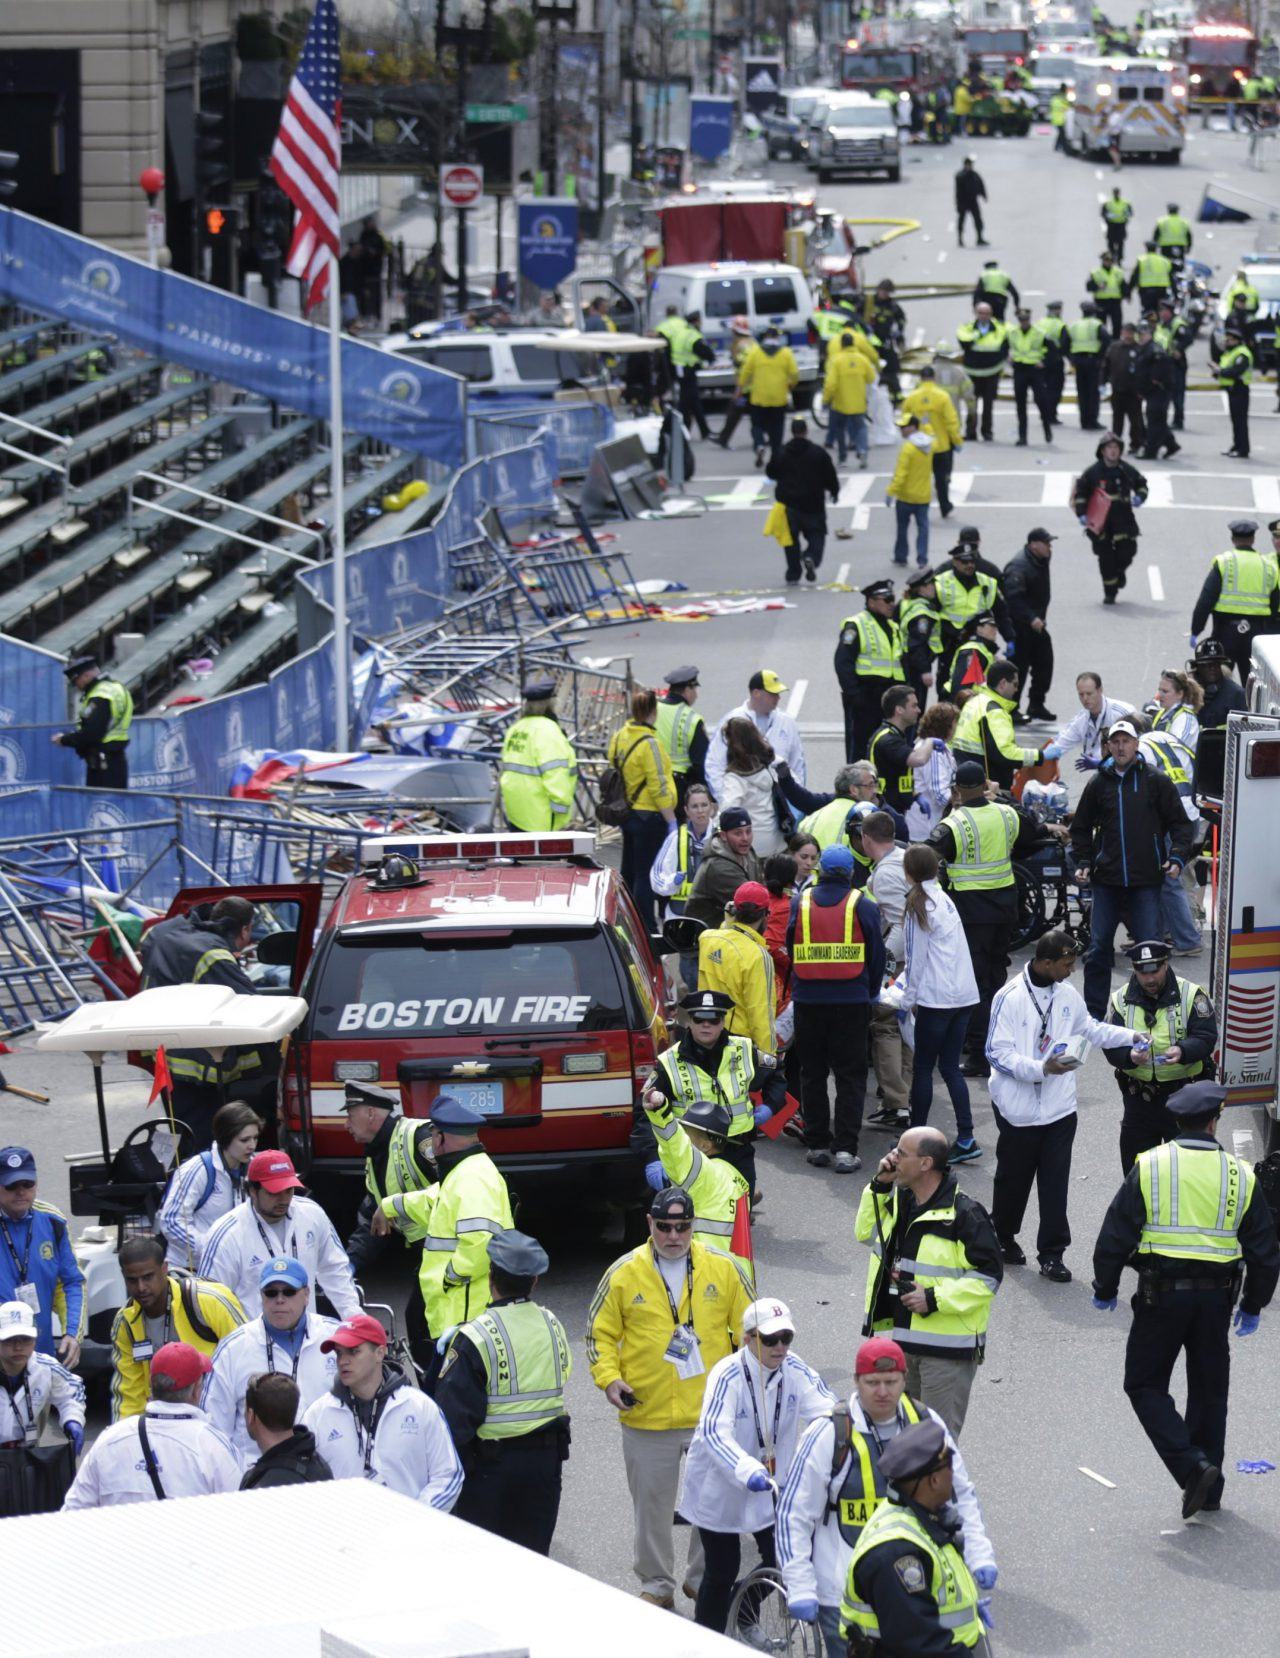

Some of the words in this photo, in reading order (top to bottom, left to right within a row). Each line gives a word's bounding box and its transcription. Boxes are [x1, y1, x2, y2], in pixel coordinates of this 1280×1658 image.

[961, 818, 977, 860] BOSTON
[807, 946, 832, 960] COMMAND
[833, 945, 861, 960] LEADERSHIP
[337, 997, 506, 1031] BOSTON
[511, 996, 591, 1023] FIRE
[1239, 1067, 1272, 1084] Stand
[469, 1091, 496, 1107] 285
[1227, 1159, 1238, 1219] POLICE
[771, 1305, 783, 1318] B
[484, 1320, 509, 1381] BOSTON
